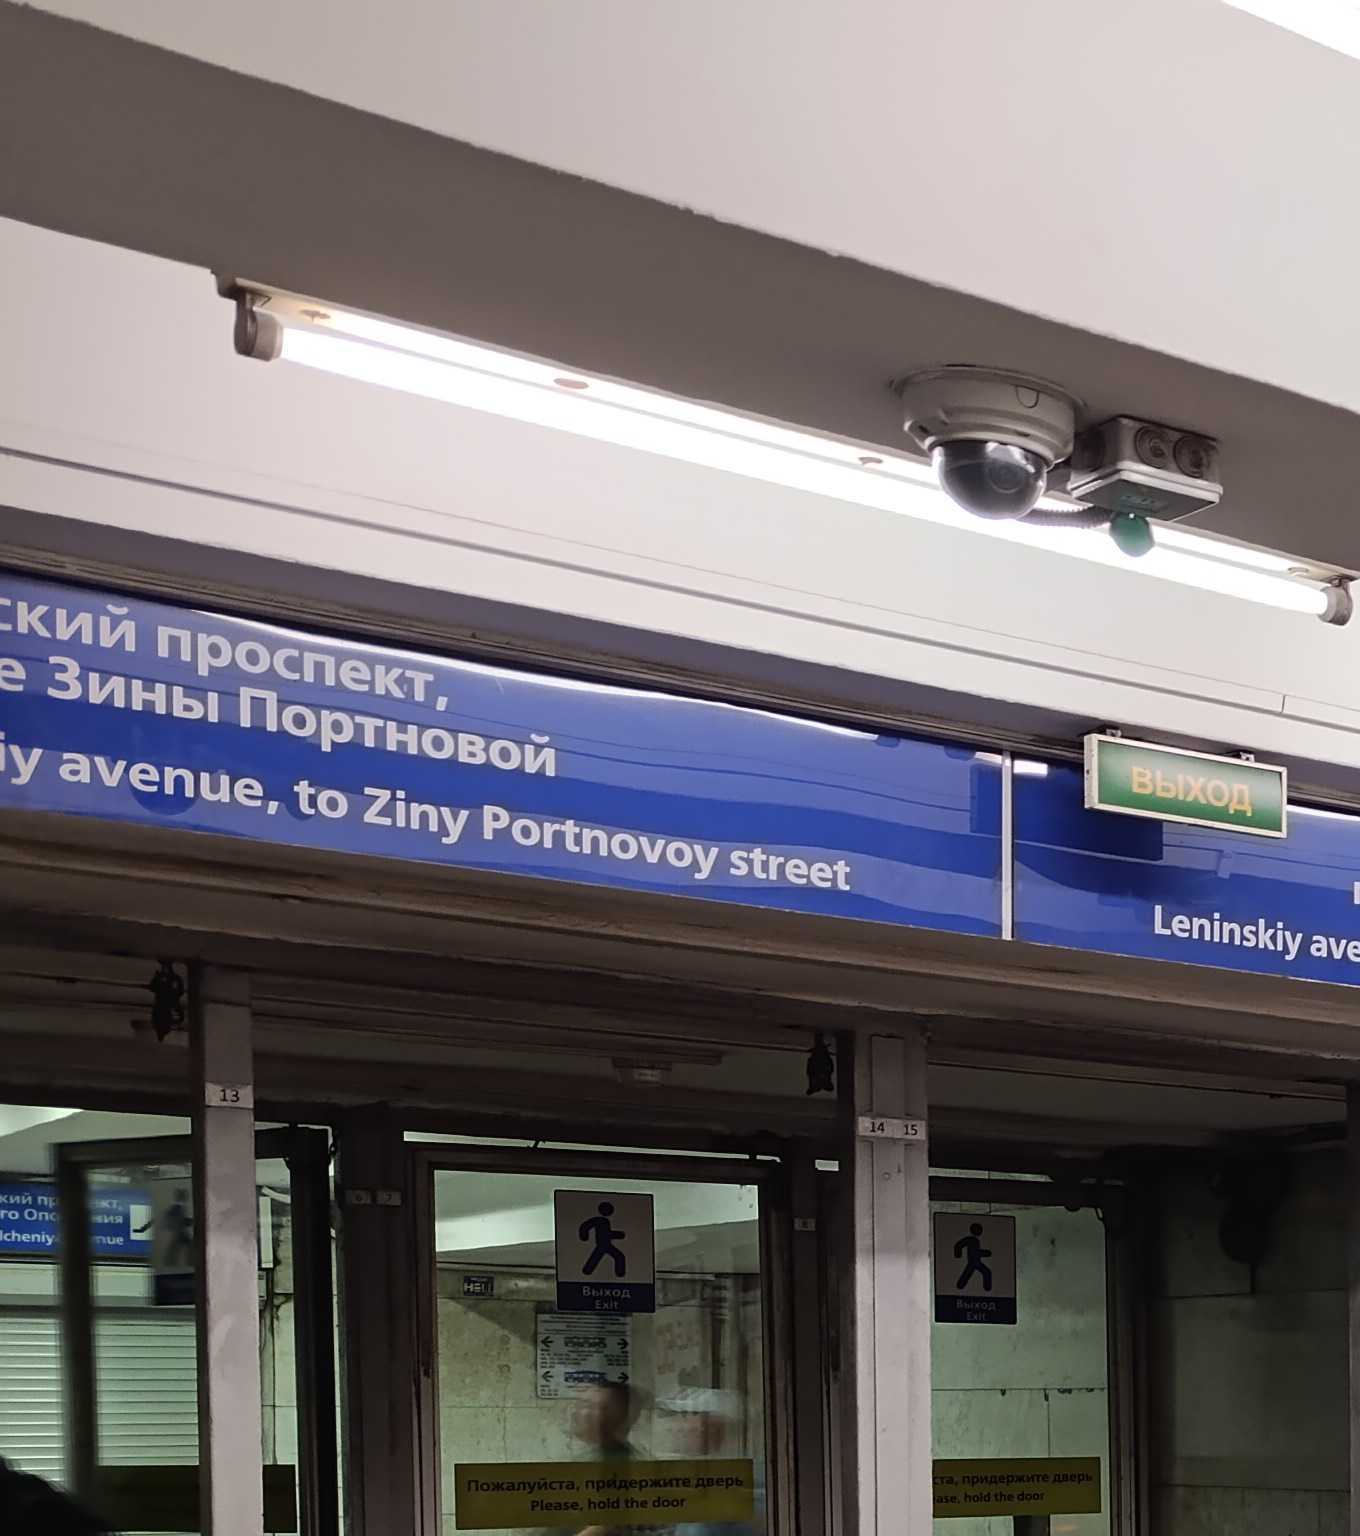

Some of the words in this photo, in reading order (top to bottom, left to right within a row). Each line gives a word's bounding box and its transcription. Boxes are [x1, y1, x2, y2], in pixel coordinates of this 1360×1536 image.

[157, 625, 449, 712] проспект,
[47, 655, 219, 723] Зины
[239, 686, 556, 777] Портновой
[1131, 766, 1253, 817] ВЫХОД
[58, 751, 279, 815] avenue,
[293, 779, 349, 818] to
[363, 786, 469, 845] Ziny
[483, 804, 719, 881] Portnovoy
[729, 846, 850, 891] street
[1154, 904, 1303, 961] Leninskiy
[219, 1088, 240, 1103] 13
[869, 1121, 885, 1134] 14
[904, 1123, 918, 1136] 15
[582, 1286, 631, 1298] Выход
[595, 1300, 619, 1309] Exit
[467, 1478, 580, 1494] Пожалуйста,
[585, 1476, 691, 1492] придержите
[695, 1475, 744, 1491] дверь
[962, 1473, 1049, 1486] придержите
[1052, 1472, 1093, 1484] дверь
[530, 1500, 583, 1512] Please,
[587, 1498, 620, 1511] hold
[624, 1497, 649, 1510] the
[652, 1496, 686, 1509] door
[964, 1492, 991, 1504] hold
[994, 1492, 1015, 1503] the
[1016, 1490, 1045, 1502] door
